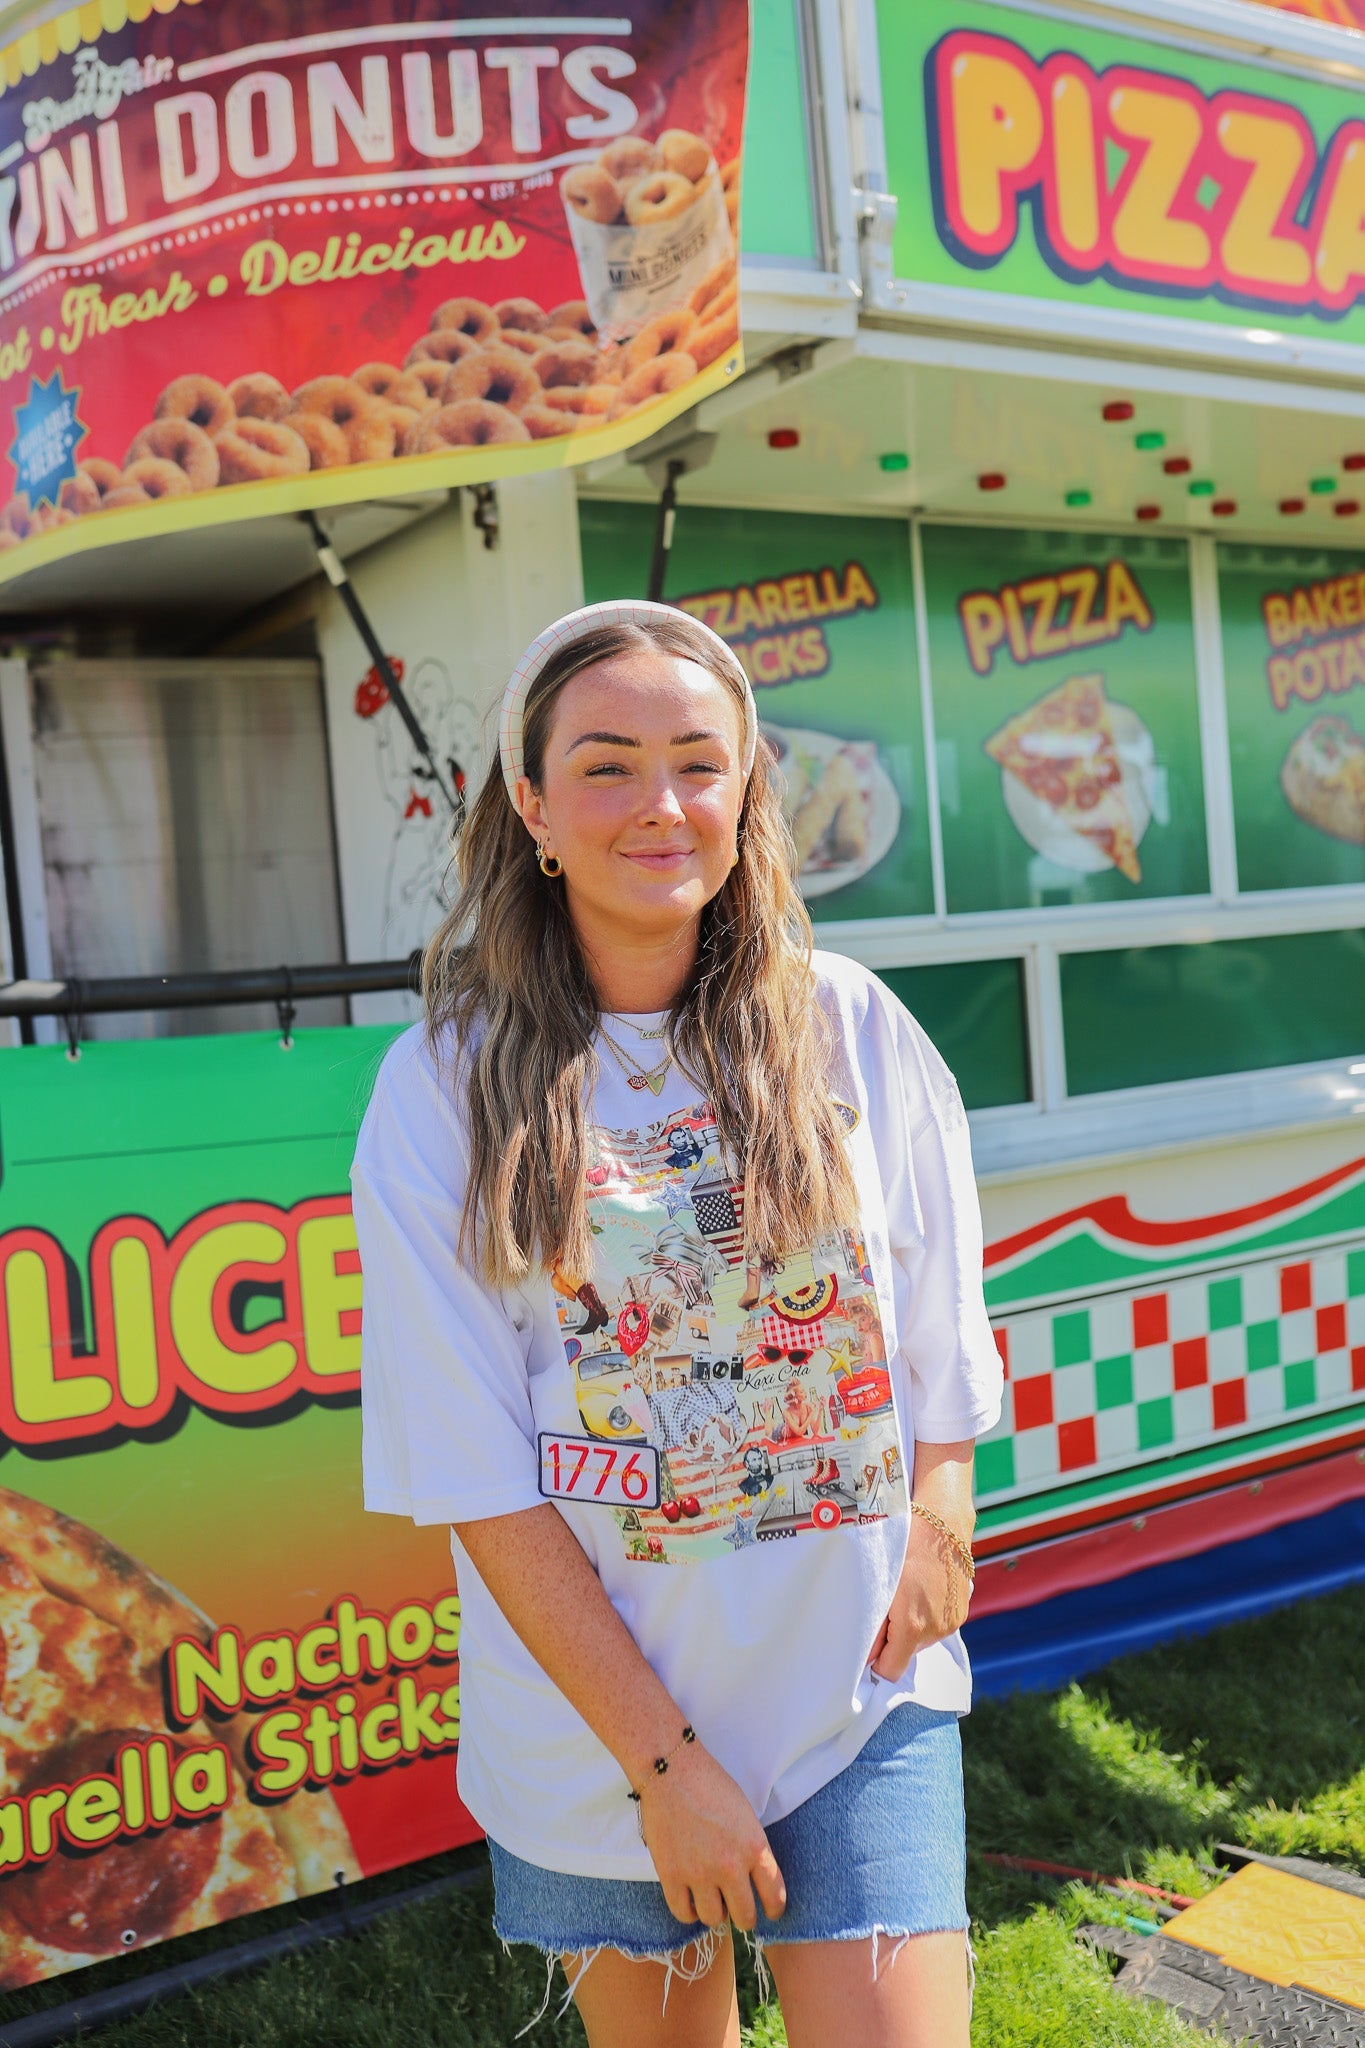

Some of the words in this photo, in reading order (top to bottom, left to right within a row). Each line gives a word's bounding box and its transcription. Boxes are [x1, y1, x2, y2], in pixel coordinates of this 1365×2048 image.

[154, 45, 639, 204] DONUTS
[60, 281, 198, 355] Fresh
[240, 220, 527, 297] Delicious
[960, 561, 1152, 673] PIZZA
[1264, 571, 1365, 647] BAKE
[1268, 630, 1365, 713] POTA
[778, 1364, 811, 1383] Cola
[547, 1442, 649, 1501] 1776
[172, 1593, 461, 1722] Nachos
[254, 1675, 461, 1794] Sticks
